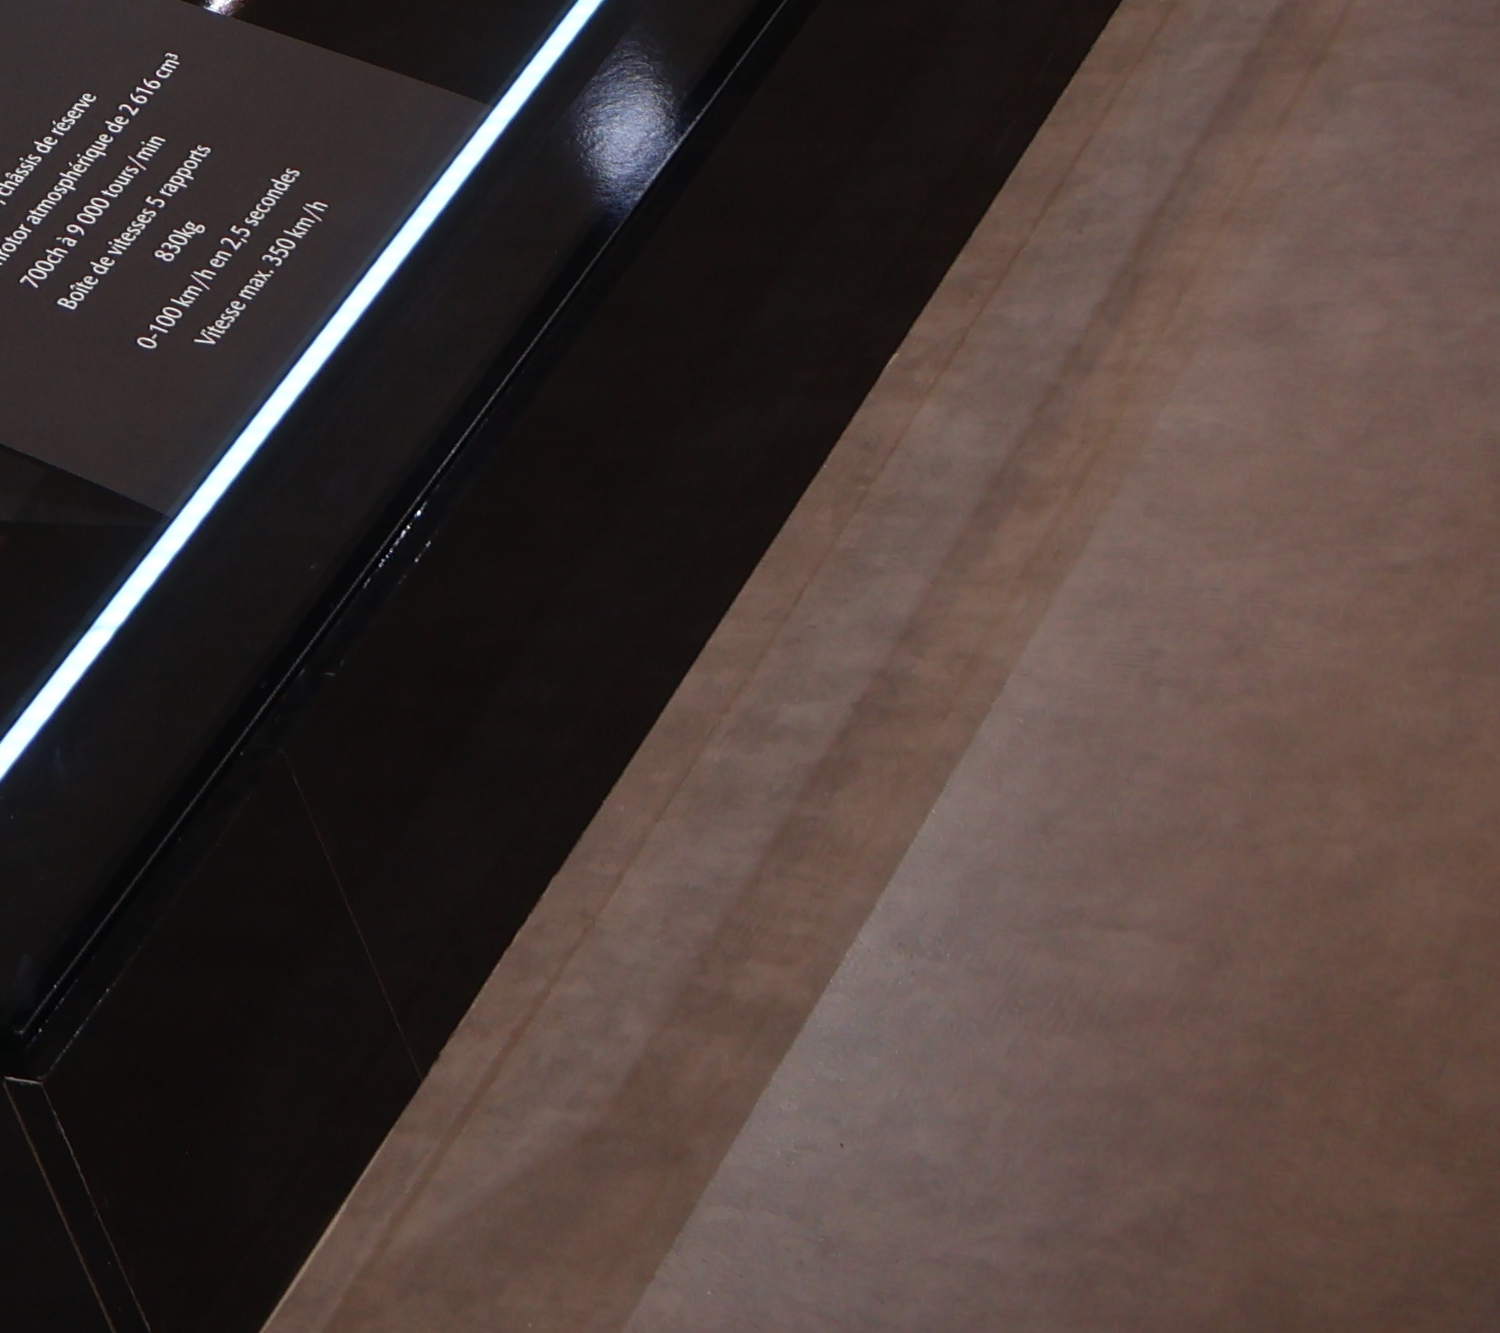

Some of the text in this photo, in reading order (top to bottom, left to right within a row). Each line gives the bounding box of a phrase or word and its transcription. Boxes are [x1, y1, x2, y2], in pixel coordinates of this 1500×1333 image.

[26, 133, 113, 225] atmosphérique
[105, 116, 129, 133] de
[155, 52, 180, 79] cm³
[33, 136, 58, 153] de
[51, 93, 97, 136] réserve
[19, 247, 68, 288] 700ch
[56, 237, 77, 247] à
[100, 136, 166, 198] tours/min
[56, 144, 211, 310] Boîte de vitesses 5 rapports
[136, 167, 300, 349] 0-100 km/h en 2,5 secondes
[154, 220, 205, 262] 830kg
[193, 201, 328, 344] Vitesse max. 350 km/h
